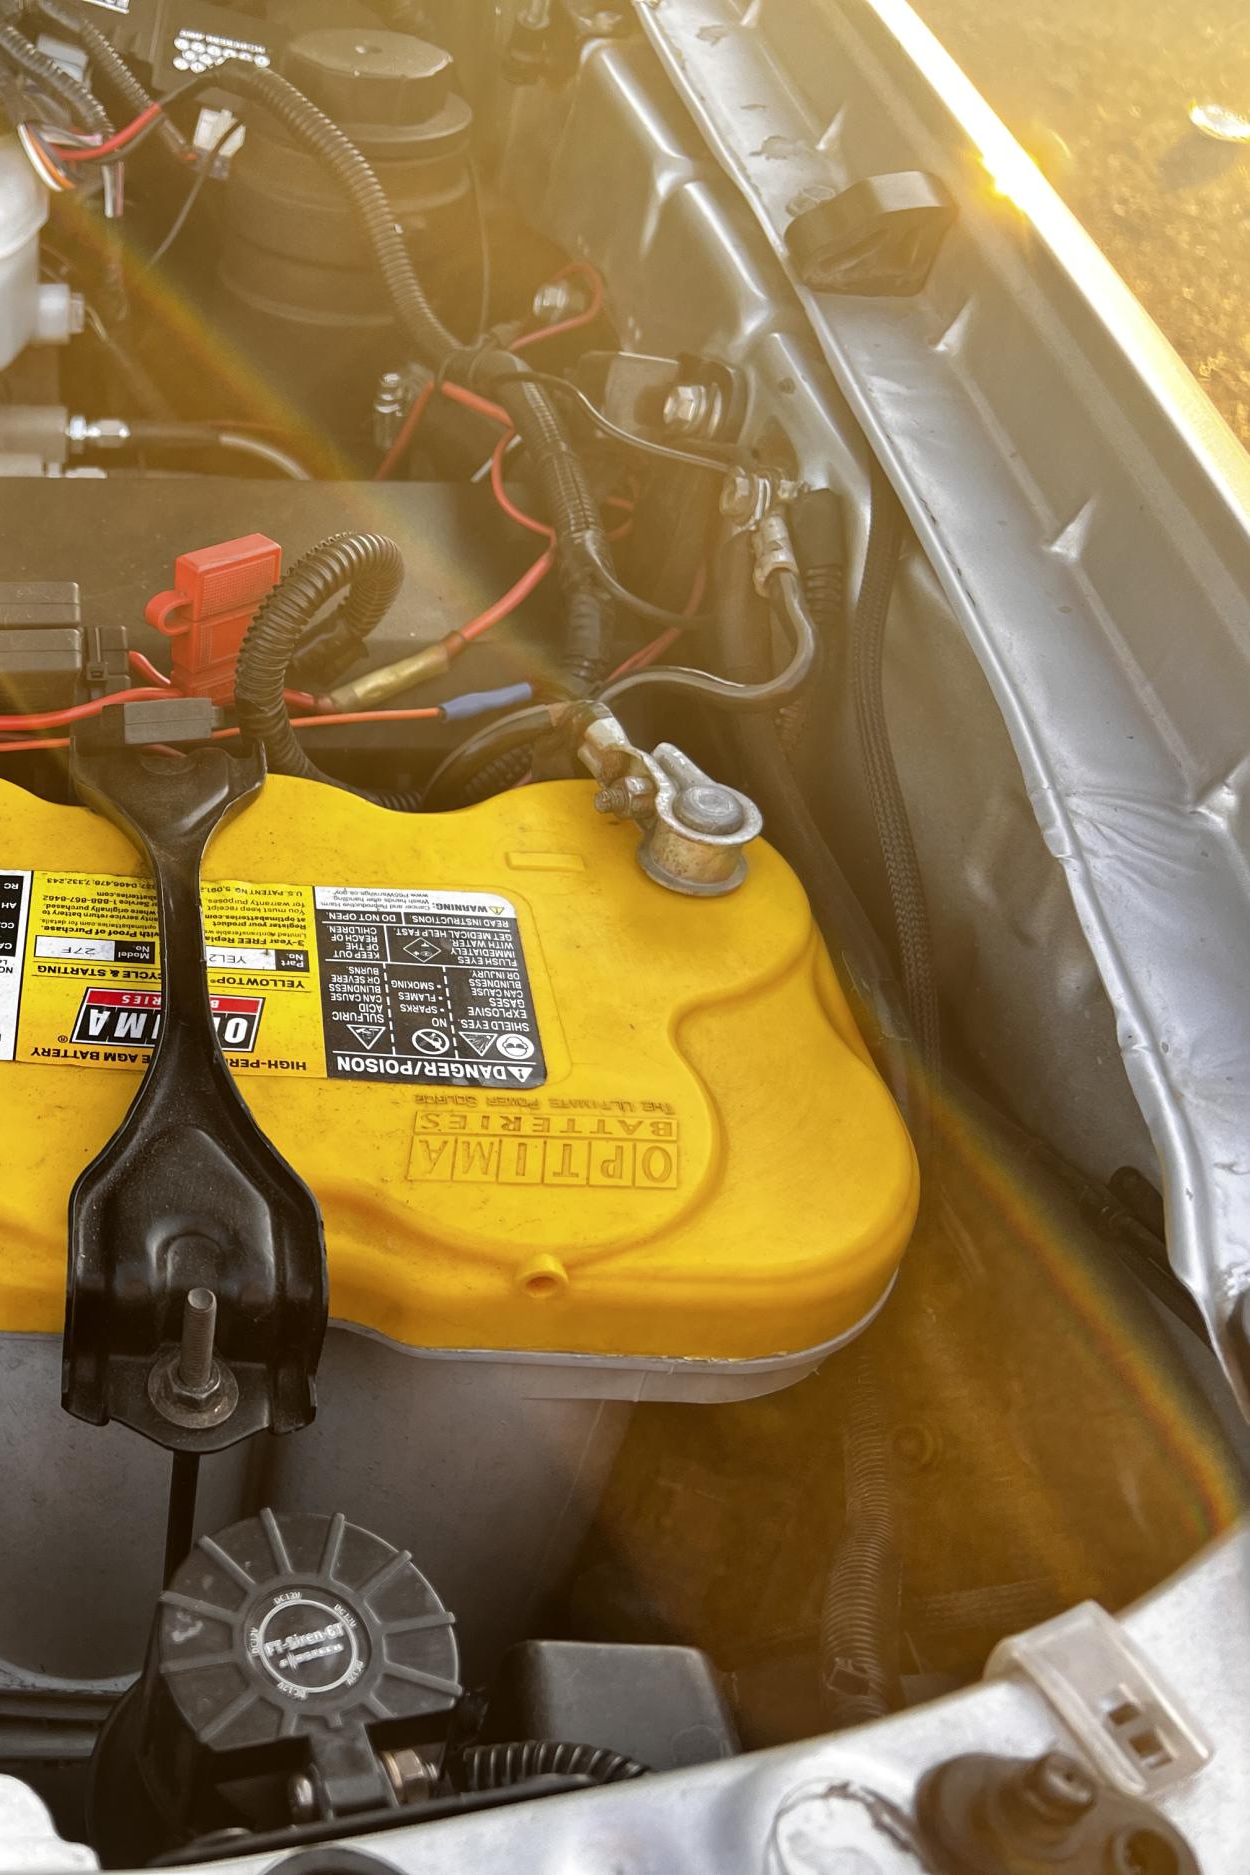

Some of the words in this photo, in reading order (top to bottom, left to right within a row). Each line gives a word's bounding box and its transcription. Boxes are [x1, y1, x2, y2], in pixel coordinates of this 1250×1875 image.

[250, 899, 290, 907] warranty
[432, 903, 488, 912] WARNING:
[53, 910, 81, 918] battery
[326, 912, 356, 920] OPEN.
[410, 915, 481, 926] INSTRUCTIONS.
[484, 919, 508, 927] READ
[41, 926, 92, 934] Purchase.
[80, 921, 156, 930] optimabatteries.com
[327, 926, 377, 934] CHILDREN.
[393, 927, 419, 936] FAST.
[422, 929, 446, 937] HELP
[448, 931, 491, 940] MEDICAL
[493, 932, 511, 940] GET
[345, 934, 377, 942] REACH
[346, 942, 364, 950] THE
[450, 939, 485, 948] WATER.
[487, 941, 513, 949] WITH
[60, 947, 95, 955] 27F
[333, 950, 352, 958] OUT
[355, 951, 379, 959] KEEP
[450, 947, 515, 957] IMMEDIATELY
[458, 956, 483, 964] EYES
[485, 958, 516, 966] FLUSH
[37, 965, 106, 976] STARTING
[110, 969, 119, 977] &
[346, 966, 379, 975] BURNS.
[470, 970, 505, 979] INJURY.
[331, 975, 365, 983] SEVERE
[506, 972, 519, 980] OR
[391, 980, 434, 989] SMOKING
[469, 979, 521, 988] BLINDNESS
[329, 984, 381, 993] BLINDNESS
[471, 988, 500, 996] CAUSE
[503, 989, 523, 997] CAN
[331, 993, 361, 1001] CAUSE
[363, 994, 382, 1002] CAN
[398, 992, 436, 1001] FLAMES
[489, 998, 524, 1008] GASES
[359, 1004, 382, 1012] ACID
[400, 1004, 437, 1013] SPARKS
[467, 1007, 526, 1018] EXPLOSIVE
[332, 1012, 384, 1023] SULFURIC
[432, 1018, 446, 1027] NO
[458, 1019, 488, 1029] EYES.
[491, 1020, 529, 1031] SHIELD
[31, 1047, 99, 1060] BATTERY
[104, 1052, 137, 1063] AGM
[337, 1056, 506, 1079] DANGER/POISON
[420, 1113, 672, 1137] BATTERIES
[419, 1139, 672, 1183] OPTIMA
